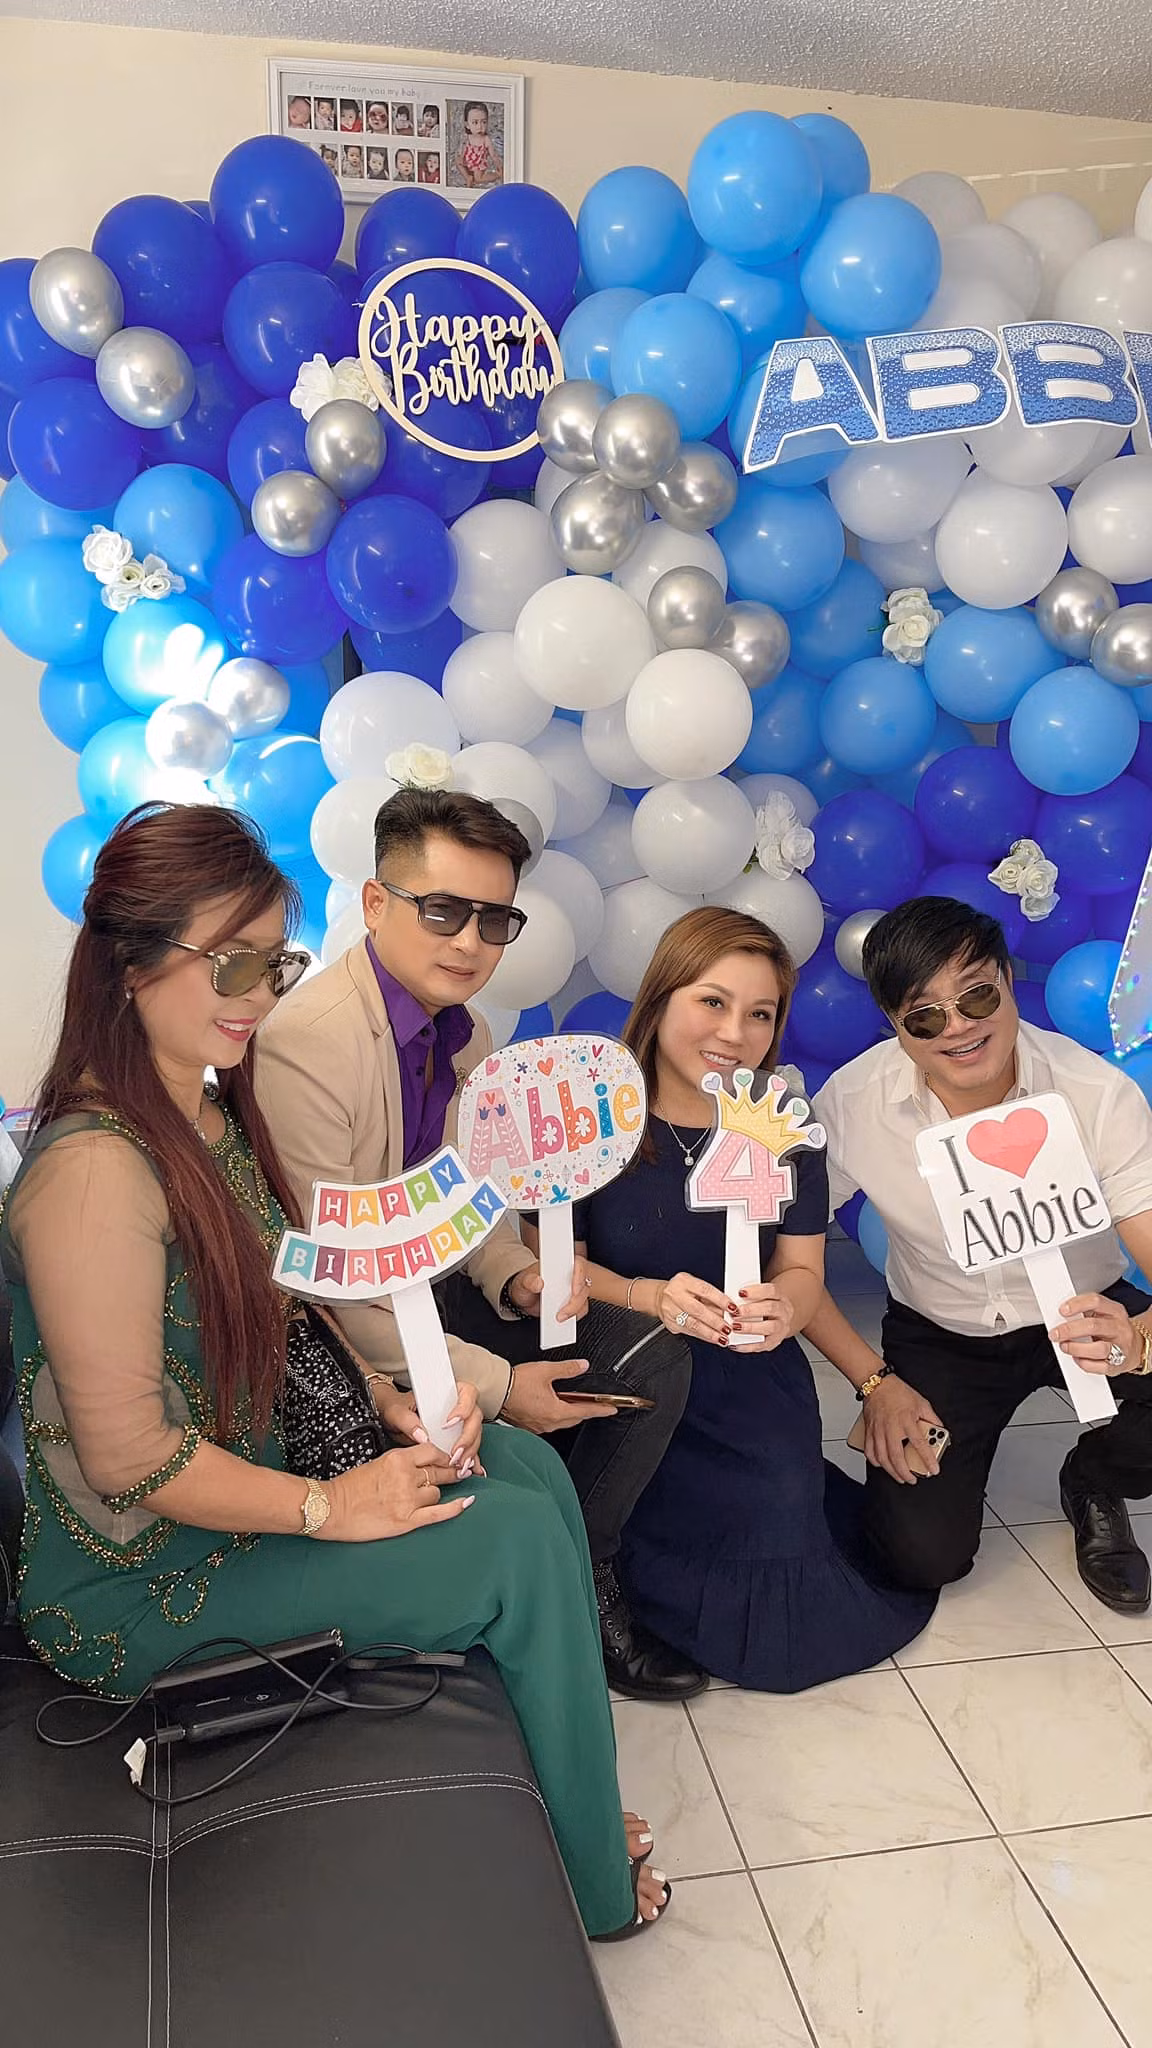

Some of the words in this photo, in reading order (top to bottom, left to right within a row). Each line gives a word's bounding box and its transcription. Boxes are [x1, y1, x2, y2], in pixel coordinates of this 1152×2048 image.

[371, 292, 545, 374] Happy
[468, 1079, 641, 1176] Abbie
[939, 1135, 972, 1196] I
[324, 1164, 453, 1217] HAPPY
[698, 1130, 788, 1223] 4
[290, 1192, 496, 1276] BIRTHDAY
[962, 1183, 1106, 1268] Abbie
